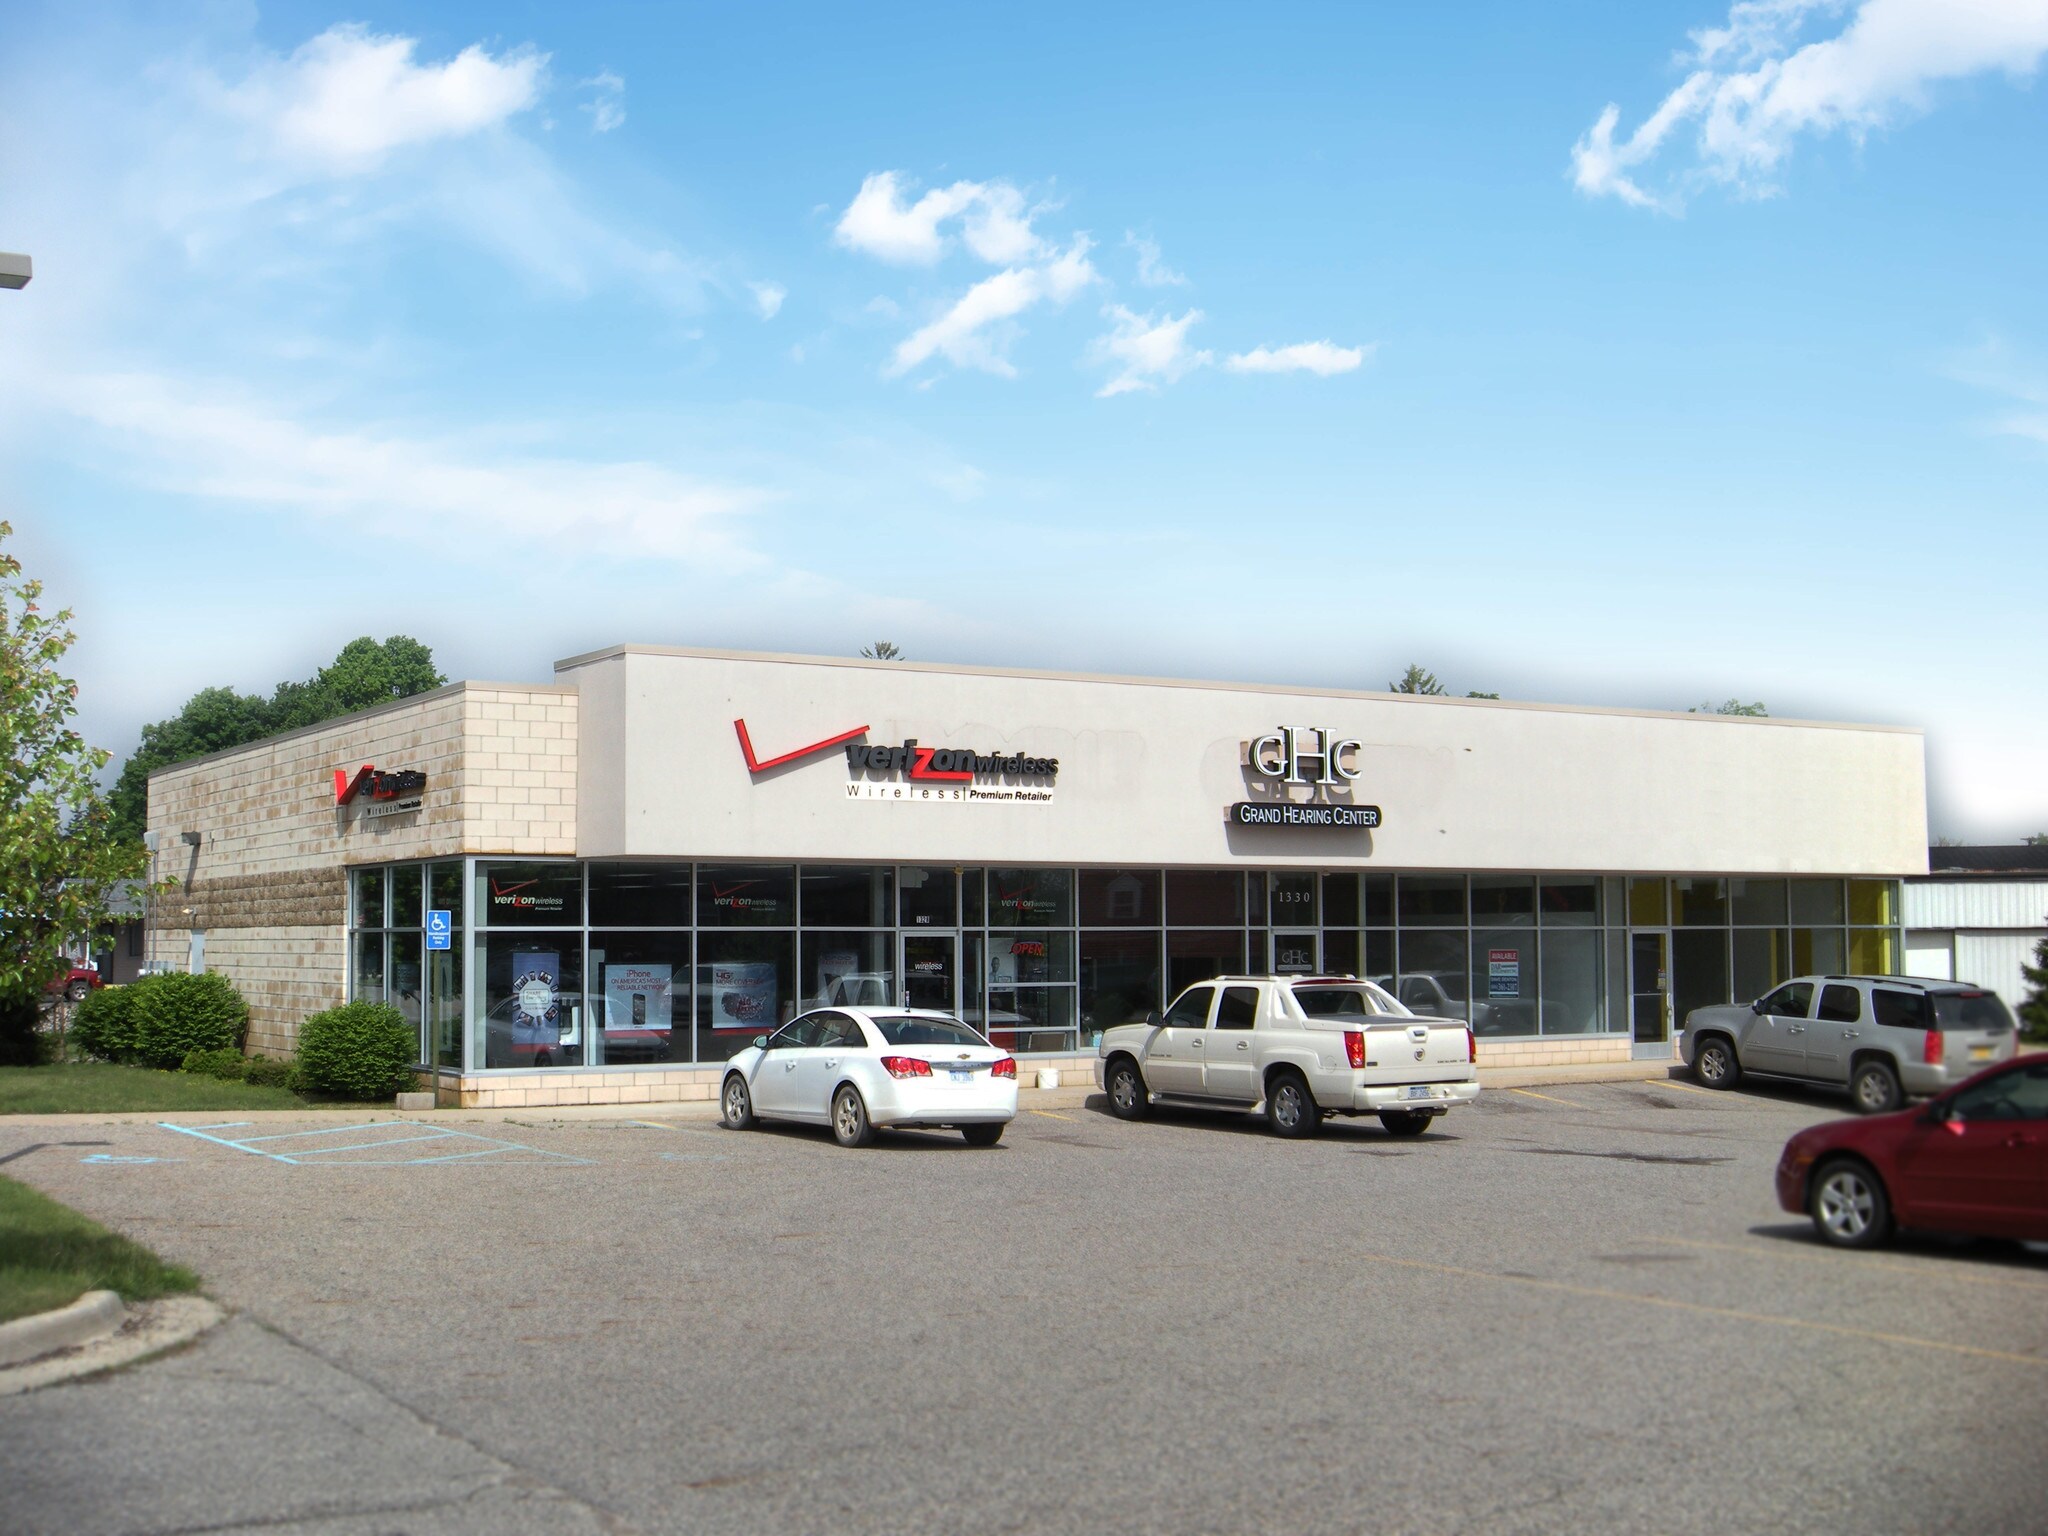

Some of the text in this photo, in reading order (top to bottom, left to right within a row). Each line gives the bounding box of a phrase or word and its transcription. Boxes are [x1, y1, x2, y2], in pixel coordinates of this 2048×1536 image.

[1249, 726, 1362, 784] GHC
[847, 786, 1053, 801] Wireless Premium Retailer
[1240, 805, 1377, 825] GRAND HEARING CENTER
[1279, 892, 1310, 902] 1330
[1012, 942, 1045, 956] OPEN
[1281, 949, 1308, 965] GHC
[914, 961, 943, 970] wireless
[626, 969, 651, 977] iPhone
